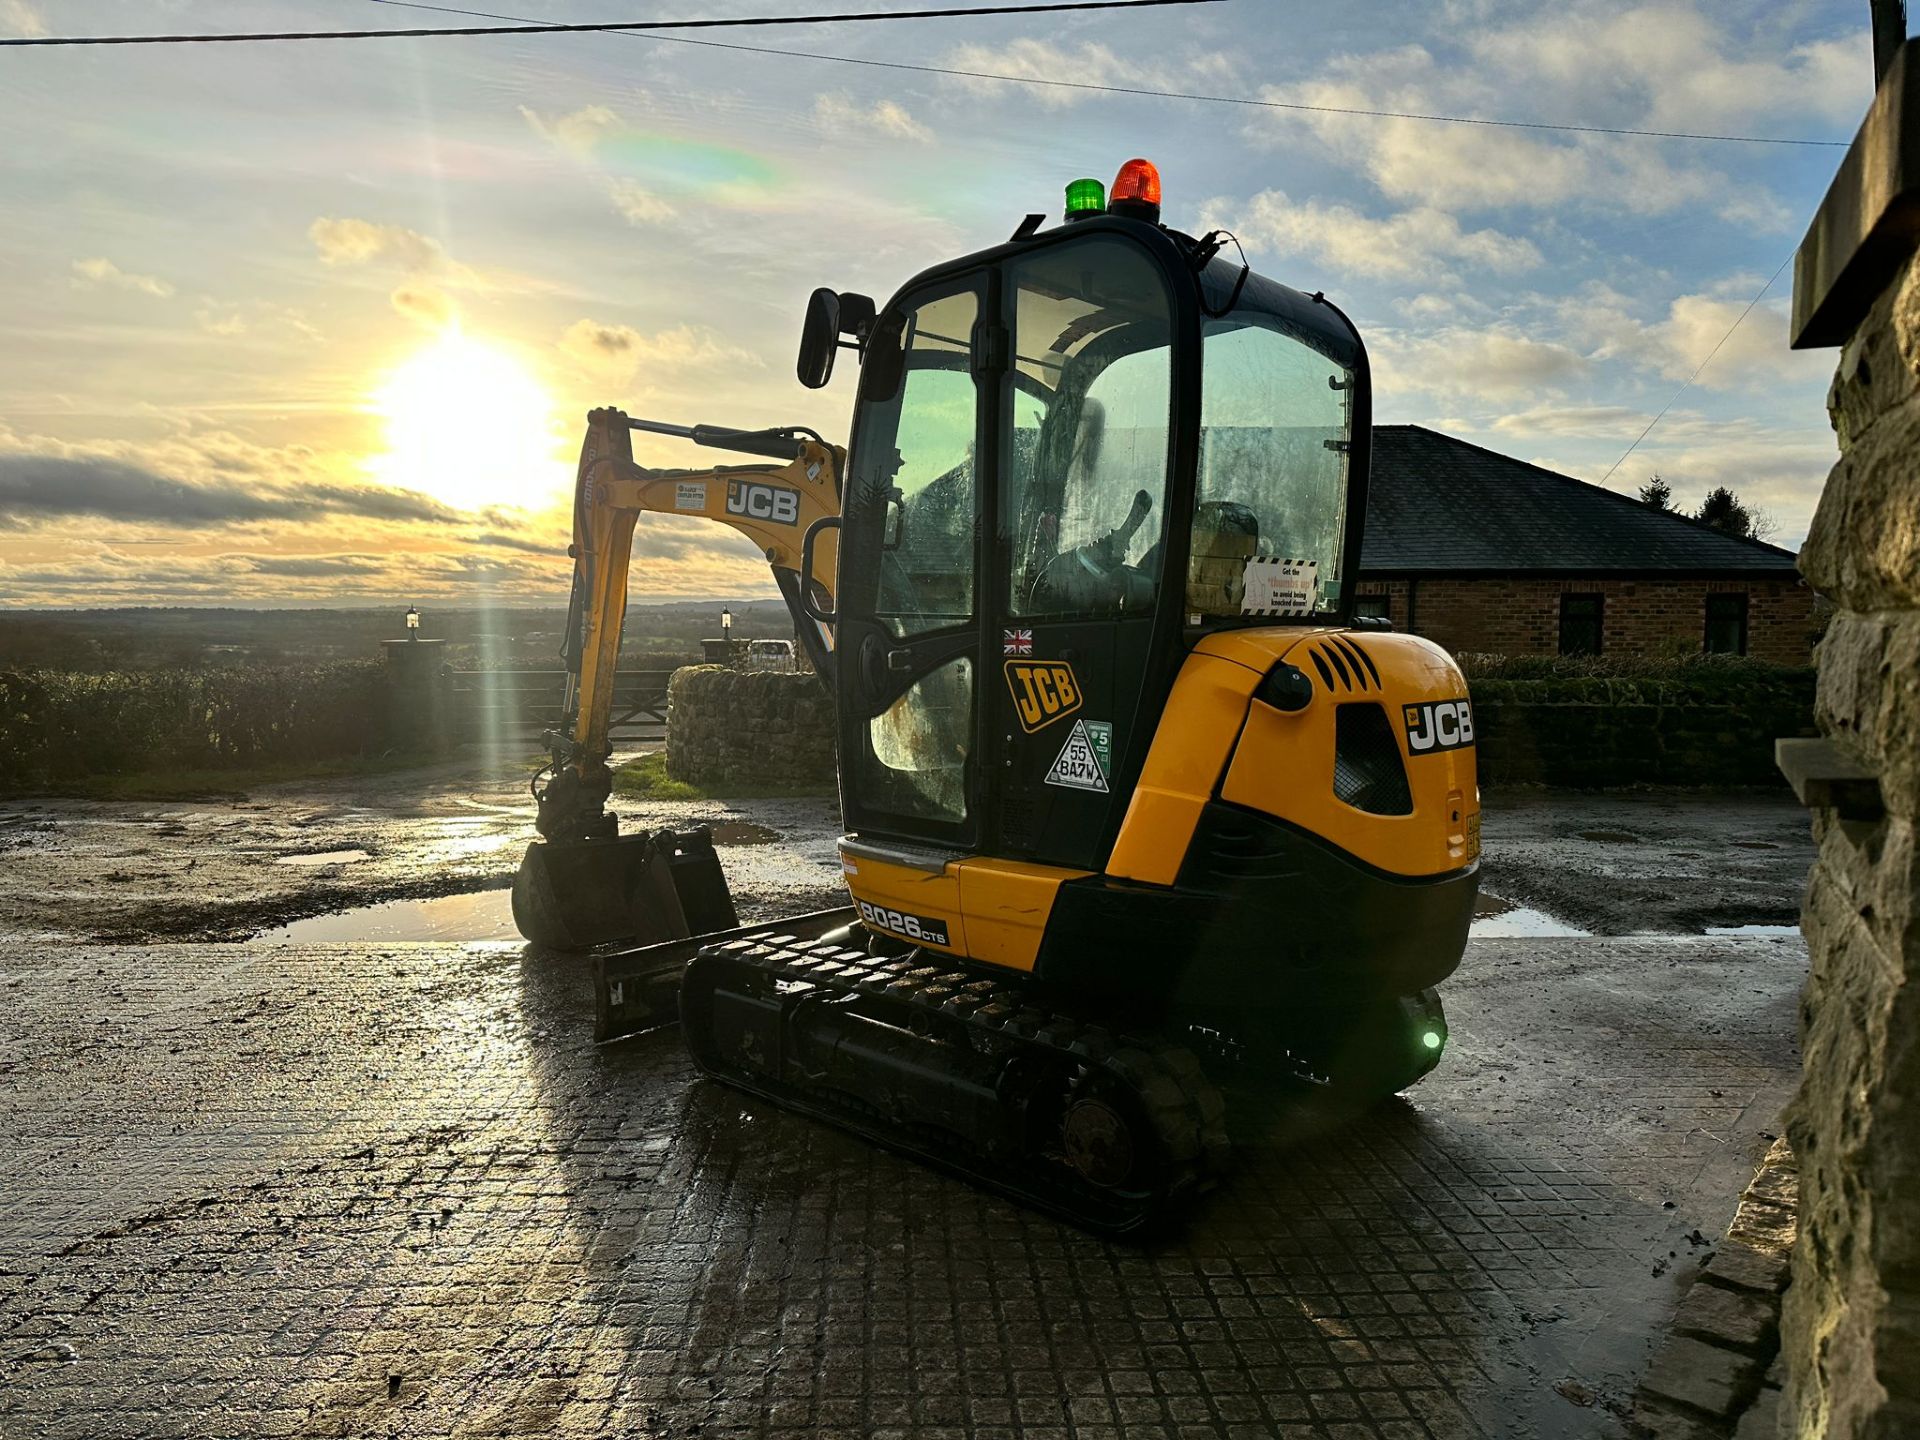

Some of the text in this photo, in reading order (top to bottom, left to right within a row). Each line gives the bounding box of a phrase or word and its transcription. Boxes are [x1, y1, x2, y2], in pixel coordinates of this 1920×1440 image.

[727, 484, 797, 522] JCB
[1294, 591, 1306, 600] being
[1015, 667, 1075, 725] JCB
[1409, 703, 1473, 750] JCB
[1099, 732, 1108, 745] 5
[1070, 745, 1086, 761] 55
[1060, 761, 1095, 780] BA7W
